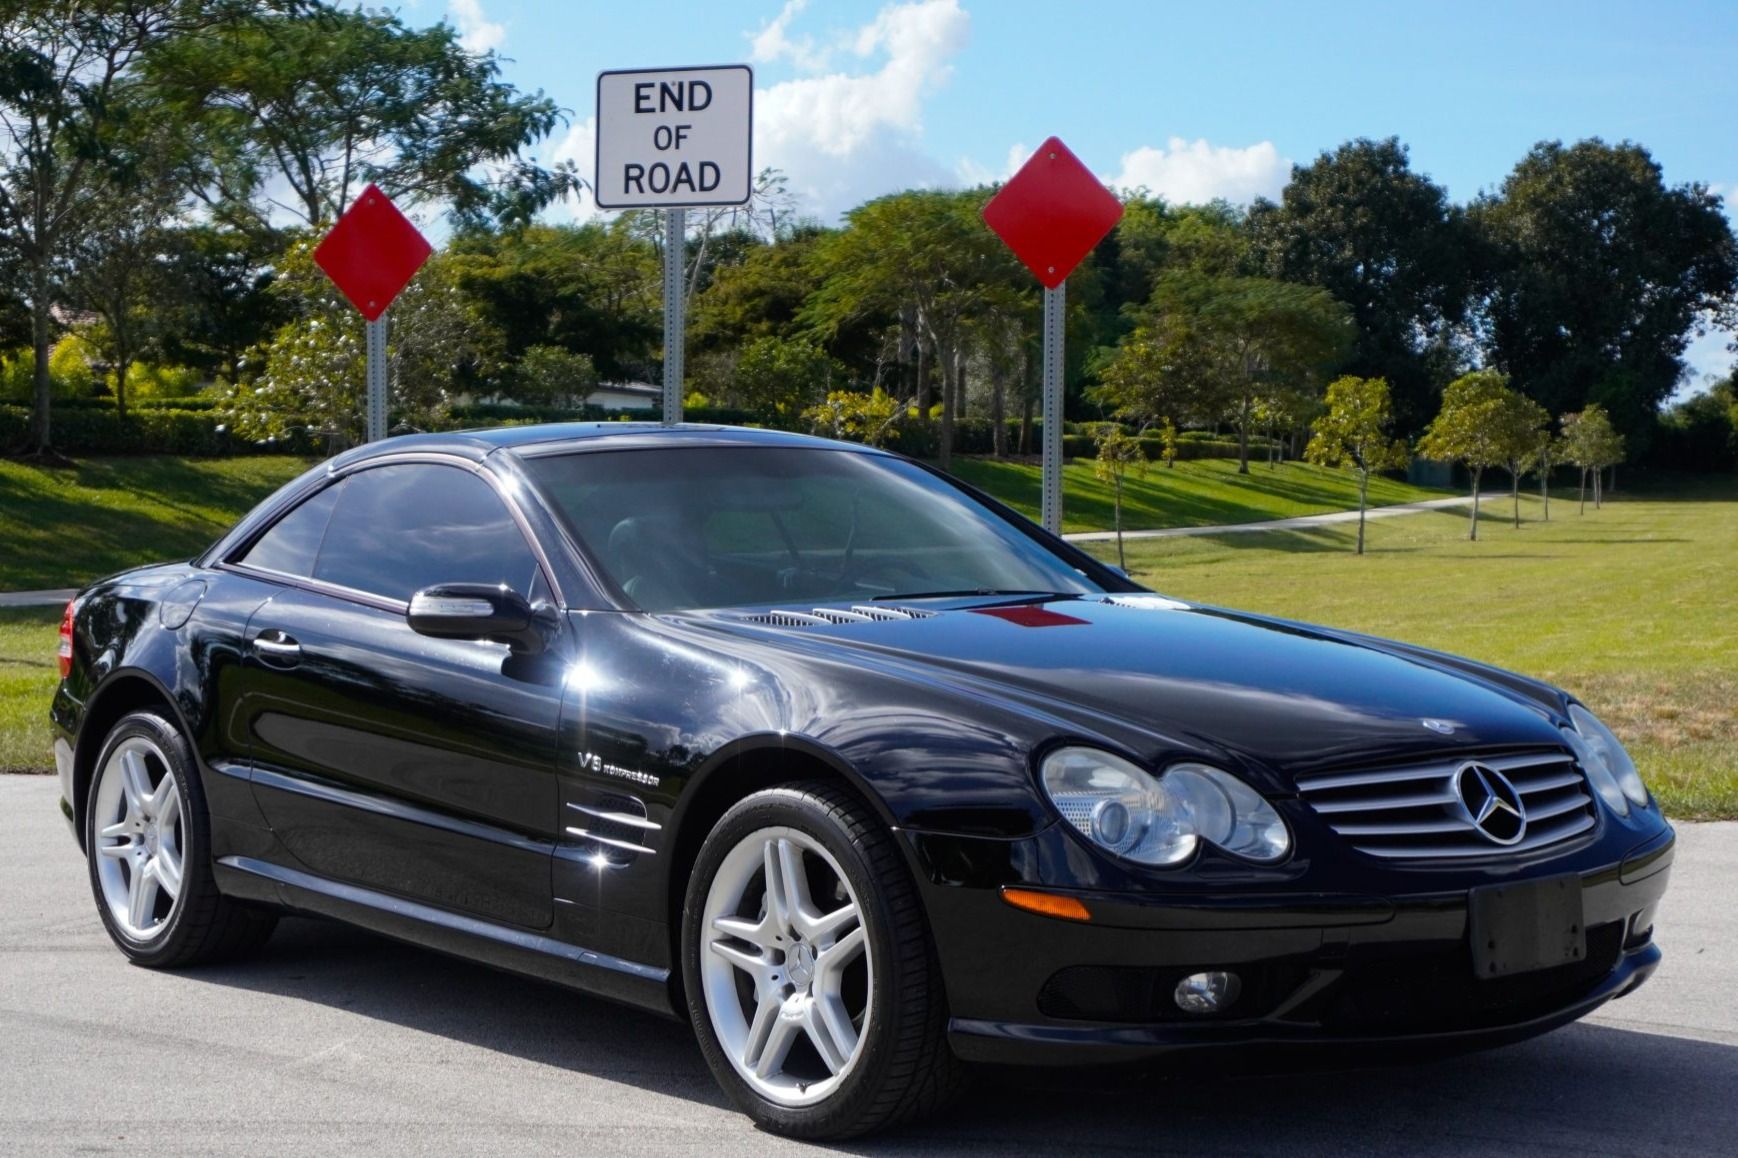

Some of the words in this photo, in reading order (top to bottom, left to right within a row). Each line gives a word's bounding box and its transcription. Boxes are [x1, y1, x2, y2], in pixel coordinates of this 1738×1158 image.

[634, 80, 713, 114] END
[653, 125, 692, 151] OF
[624, 161, 721, 194] ROAD
[578, 752, 602, 772] V8
[603, 764, 660, 787] KOMPRESSOR
